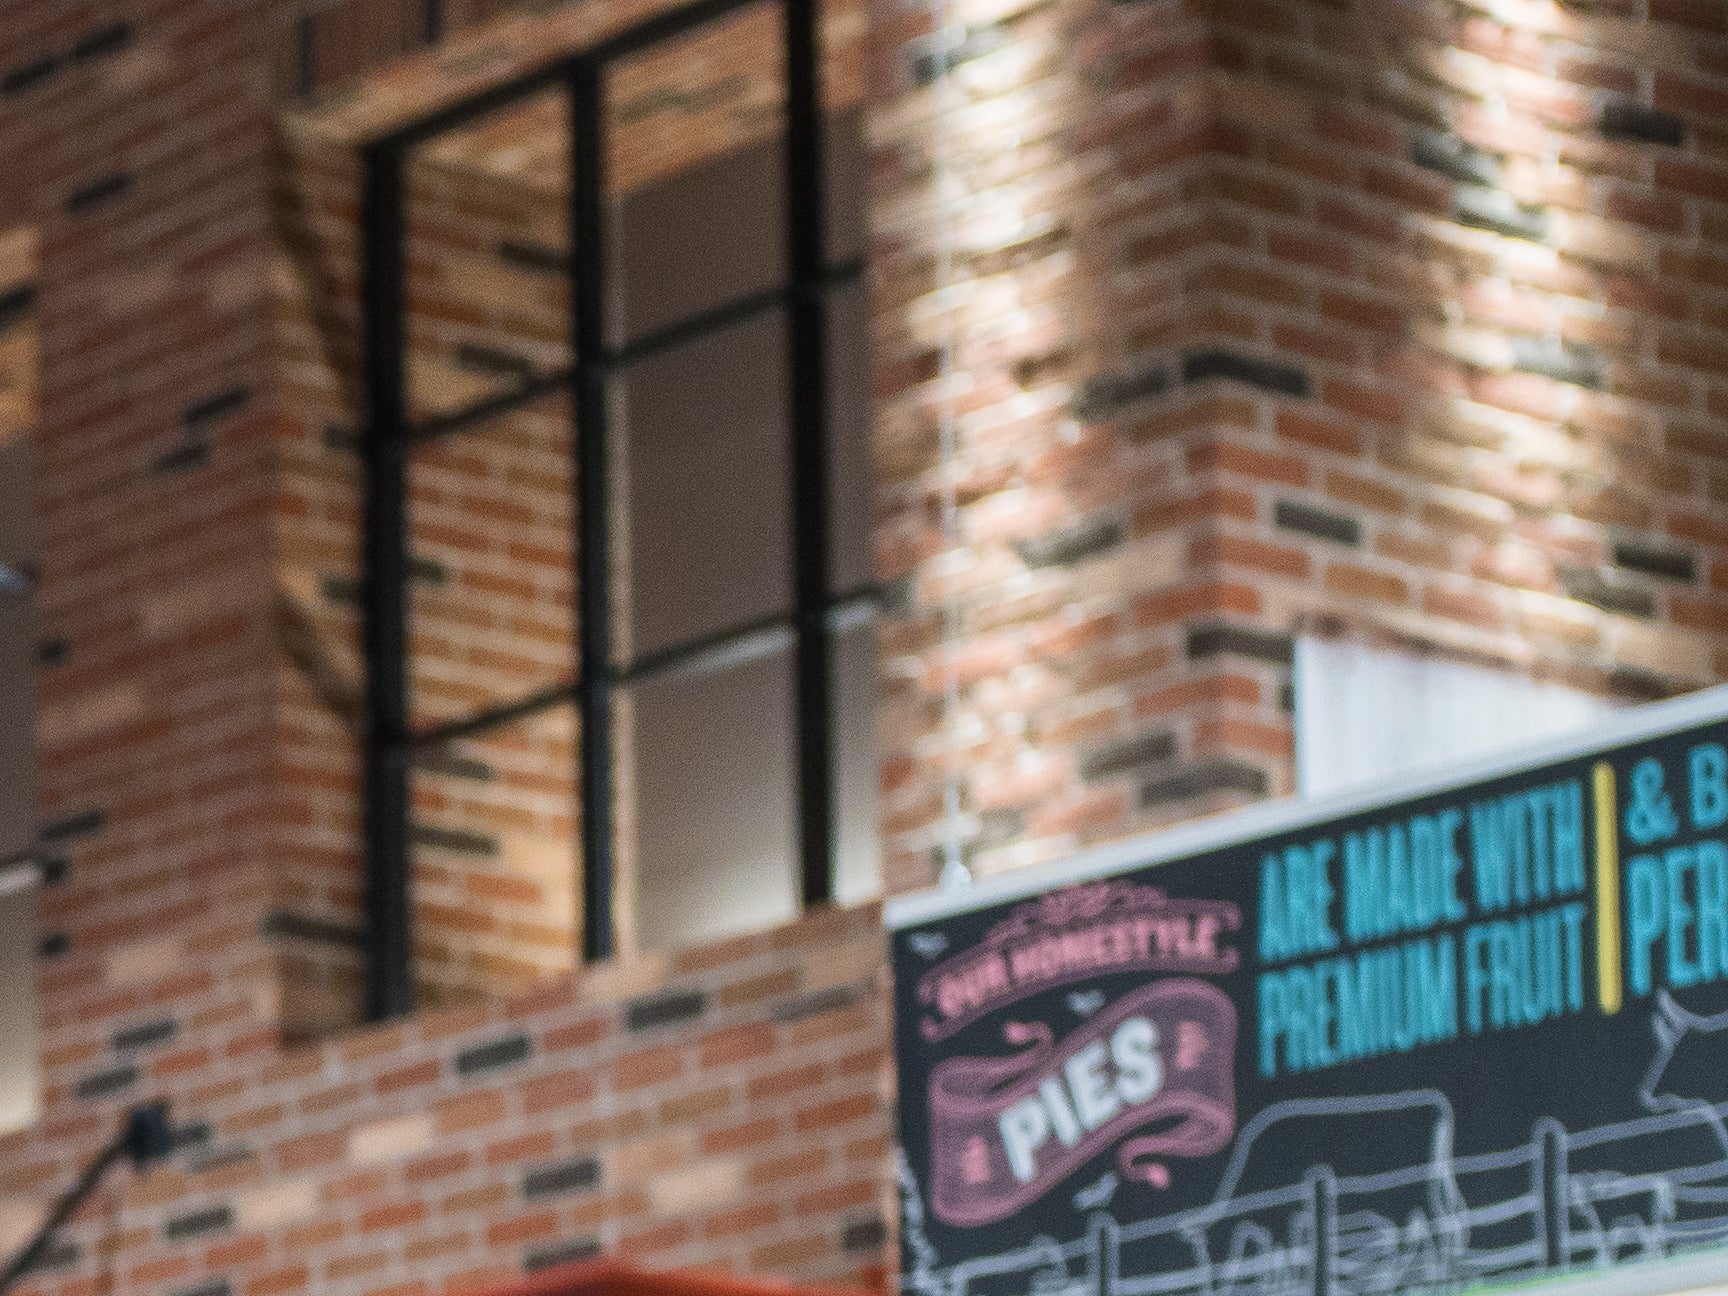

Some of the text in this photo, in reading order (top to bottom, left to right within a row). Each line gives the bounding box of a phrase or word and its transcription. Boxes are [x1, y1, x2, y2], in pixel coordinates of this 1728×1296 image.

[1257, 778, 1585, 966] ARE MADE WITH
[1625, 758, 1679, 845] &
[1010, 914, 1221, 981] HOMESTYLE
[1257, 902, 1586, 1080] PREMIUM FRUIT
[998, 1016, 1164, 1183] PIES
